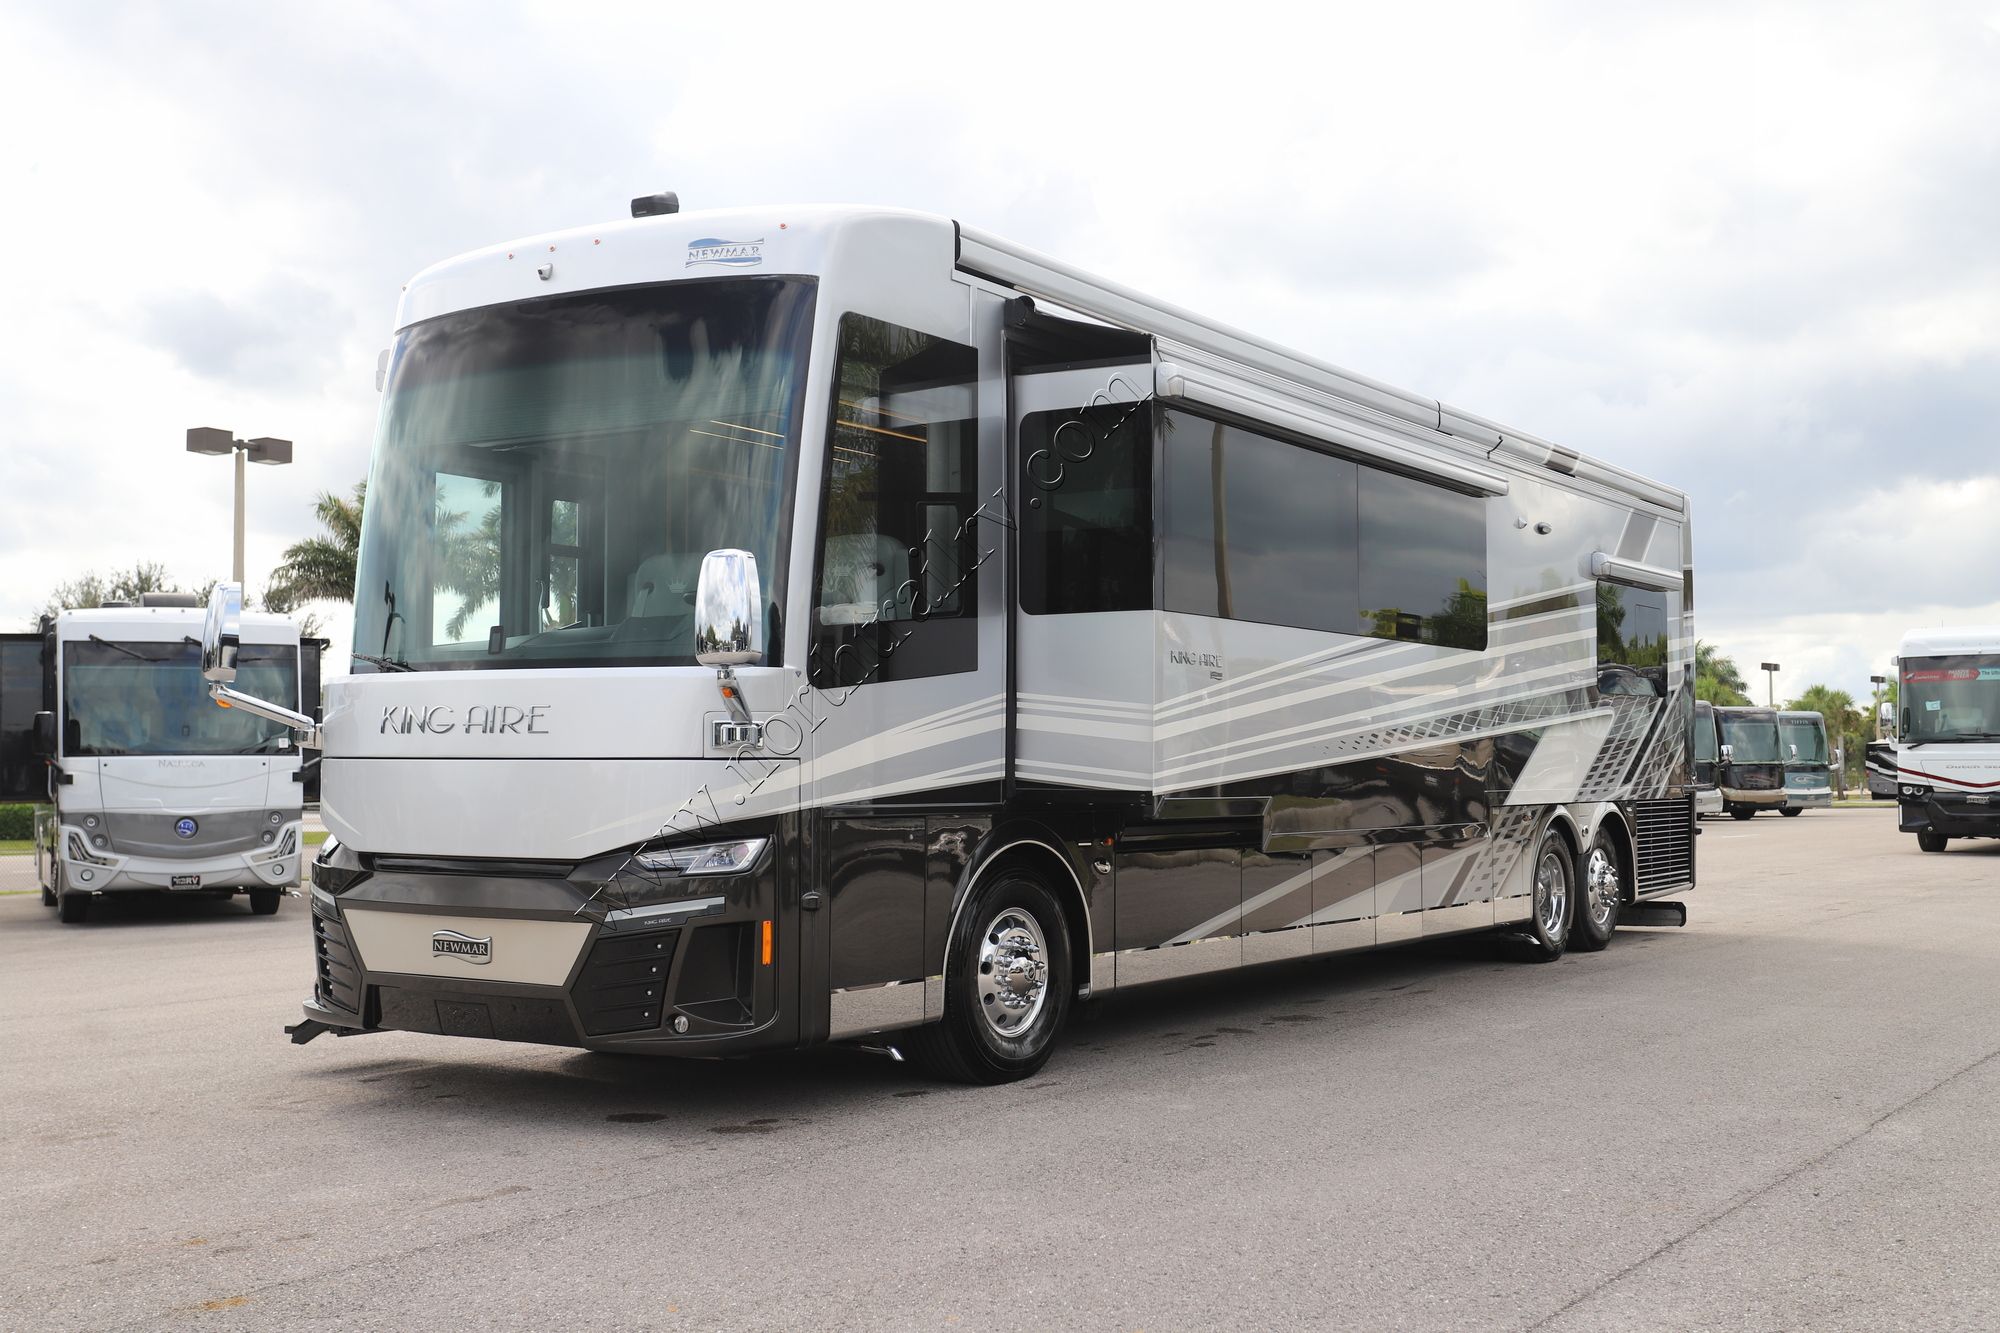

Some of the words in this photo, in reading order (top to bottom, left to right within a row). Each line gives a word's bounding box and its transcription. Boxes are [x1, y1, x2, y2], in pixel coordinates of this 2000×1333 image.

[687, 245, 761, 260] NEWMAR
[1170, 650, 1196, 666] KING
[1199, 652, 1223, 668] AIRE
[380, 704, 455, 734] KING
[463, 704, 551, 734] AIRE
[433, 940, 488, 955] NEWMAR
